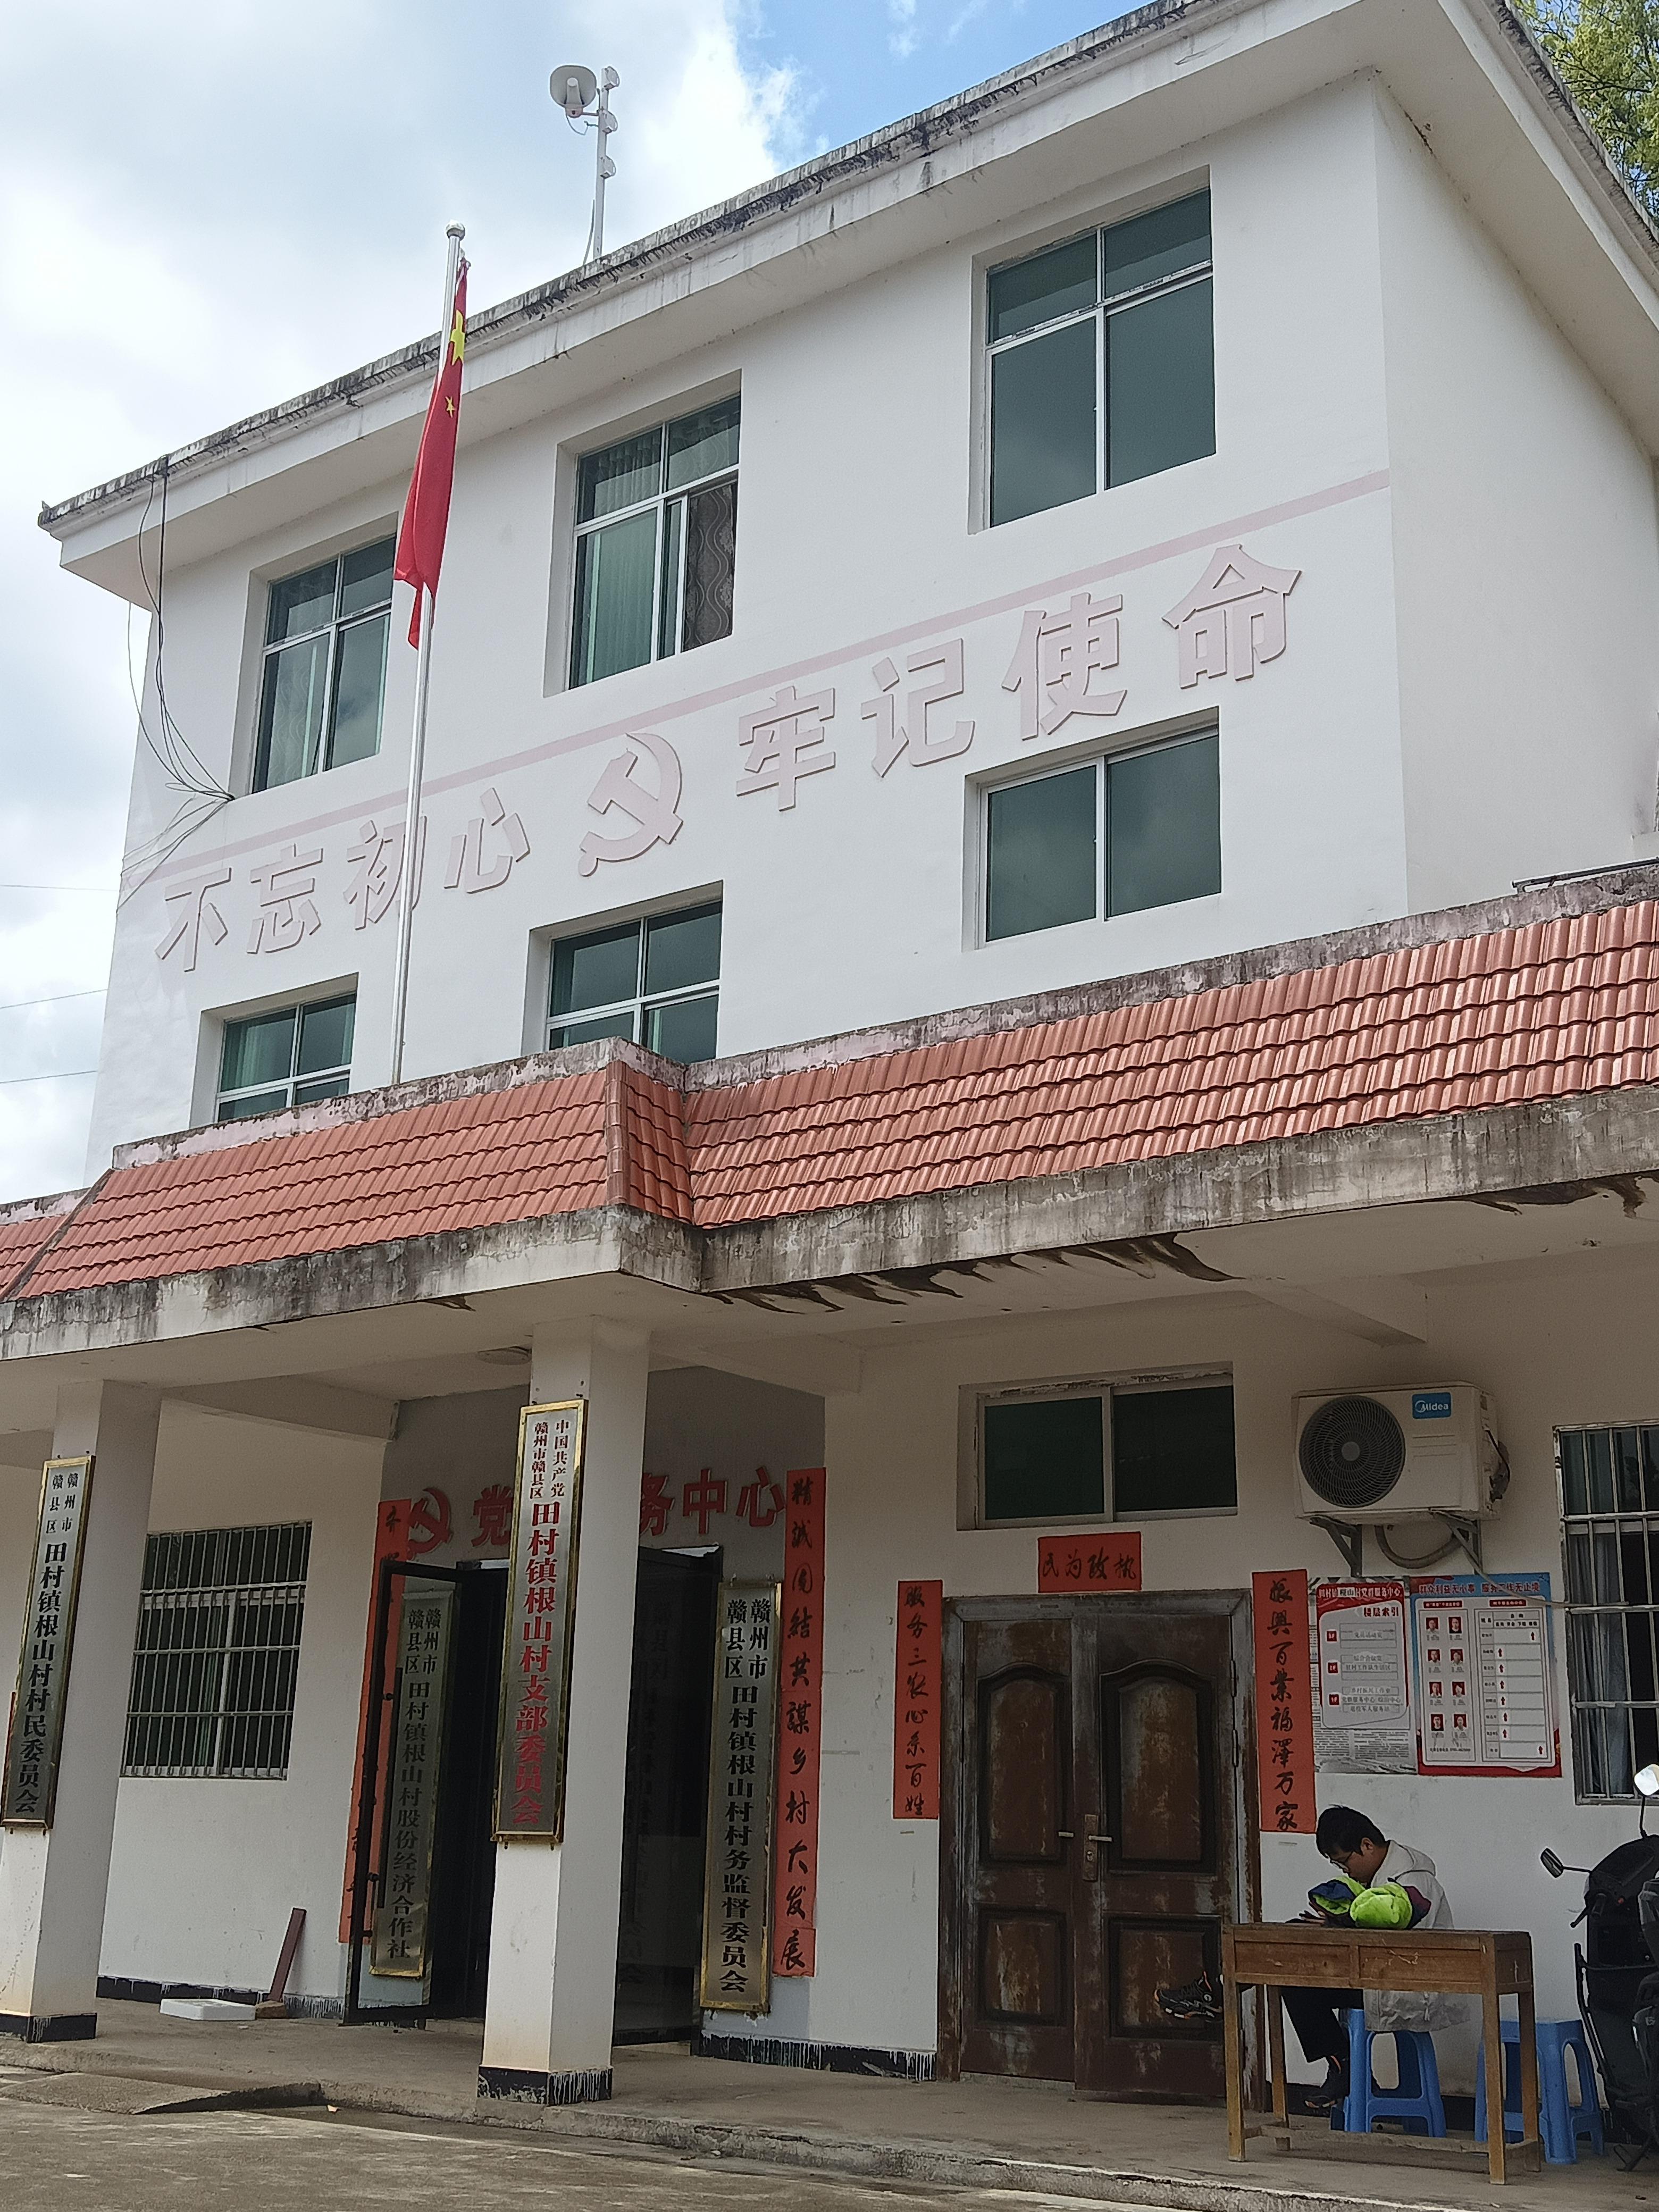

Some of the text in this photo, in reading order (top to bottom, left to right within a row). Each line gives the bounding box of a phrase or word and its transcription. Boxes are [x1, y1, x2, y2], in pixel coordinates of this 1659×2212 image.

[736, 543, 1302, 811] 牢记使命
[154, 787, 531, 972] 不忘初心
[1415, 1400, 1449, 1413] Midea
[530, 1421, 548, 1499] 赣州市赣县区
[550, 1419, 569, 1498] 中国共产党
[46, 1474, 64, 1534] 赣县区
[61, 1472, 79, 1532] 赣州市
[14, 1542, 67, 1813] 田村镇根山村村民委员会
[405, 1609, 425, 1674] 赣县区
[423, 1607, 442, 1674] 赣州市
[510, 1501, 560, 1824] 田村镇根山村支部委员会
[725, 1599, 748, 1679] 赣县区
[748, 1598, 772, 1679] 赣州市
[387, 1682, 430, 1959] 田村镇根山村股份经济合作社
[719, 1686, 759, 1992] 田村镇根山村村务监督委员会
